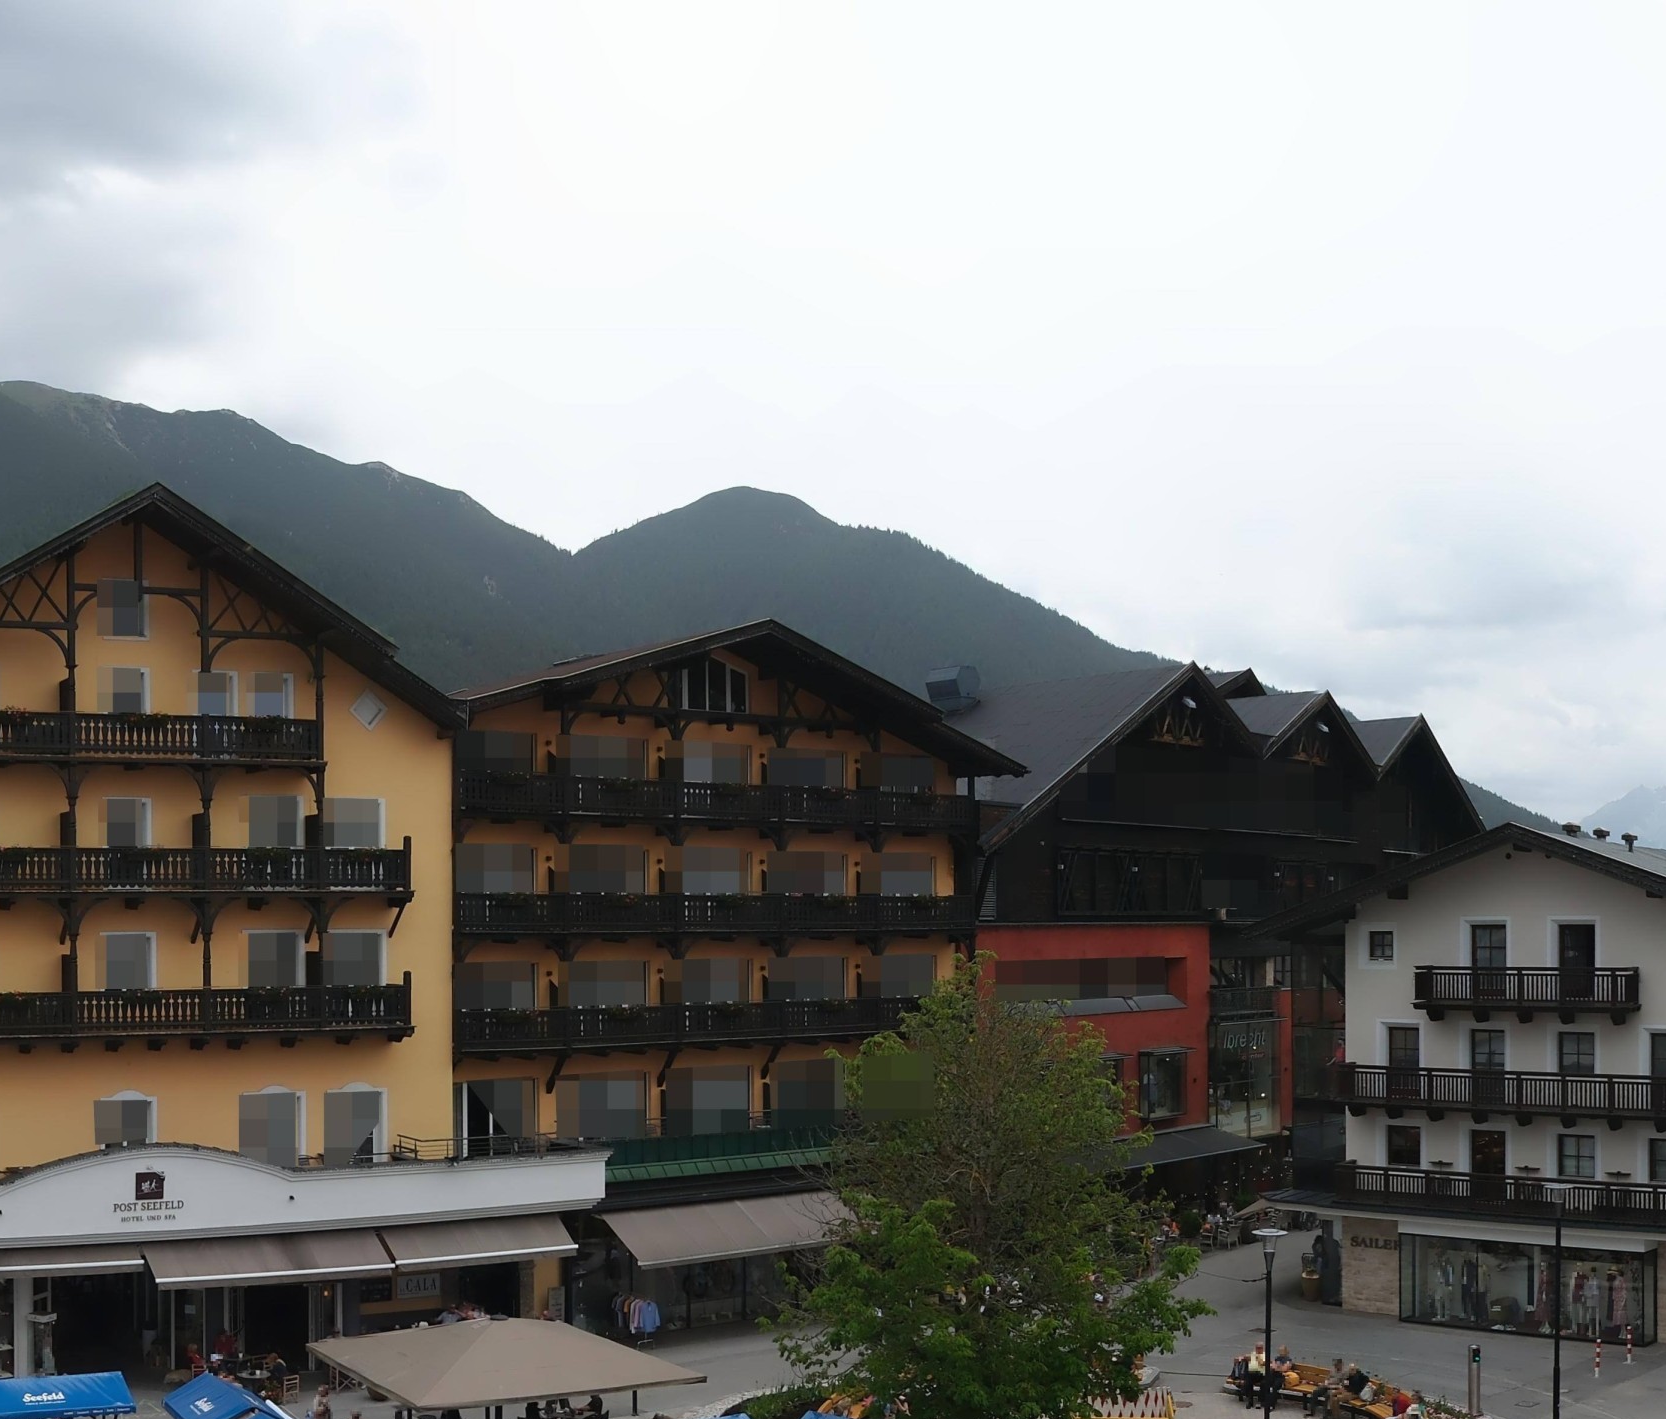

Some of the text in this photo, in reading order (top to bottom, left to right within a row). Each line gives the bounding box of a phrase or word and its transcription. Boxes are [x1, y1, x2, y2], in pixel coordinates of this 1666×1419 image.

[113, 1200, 184, 1213] POST SEEFELD
[22, 1391, 65, 1403] Seefeld
